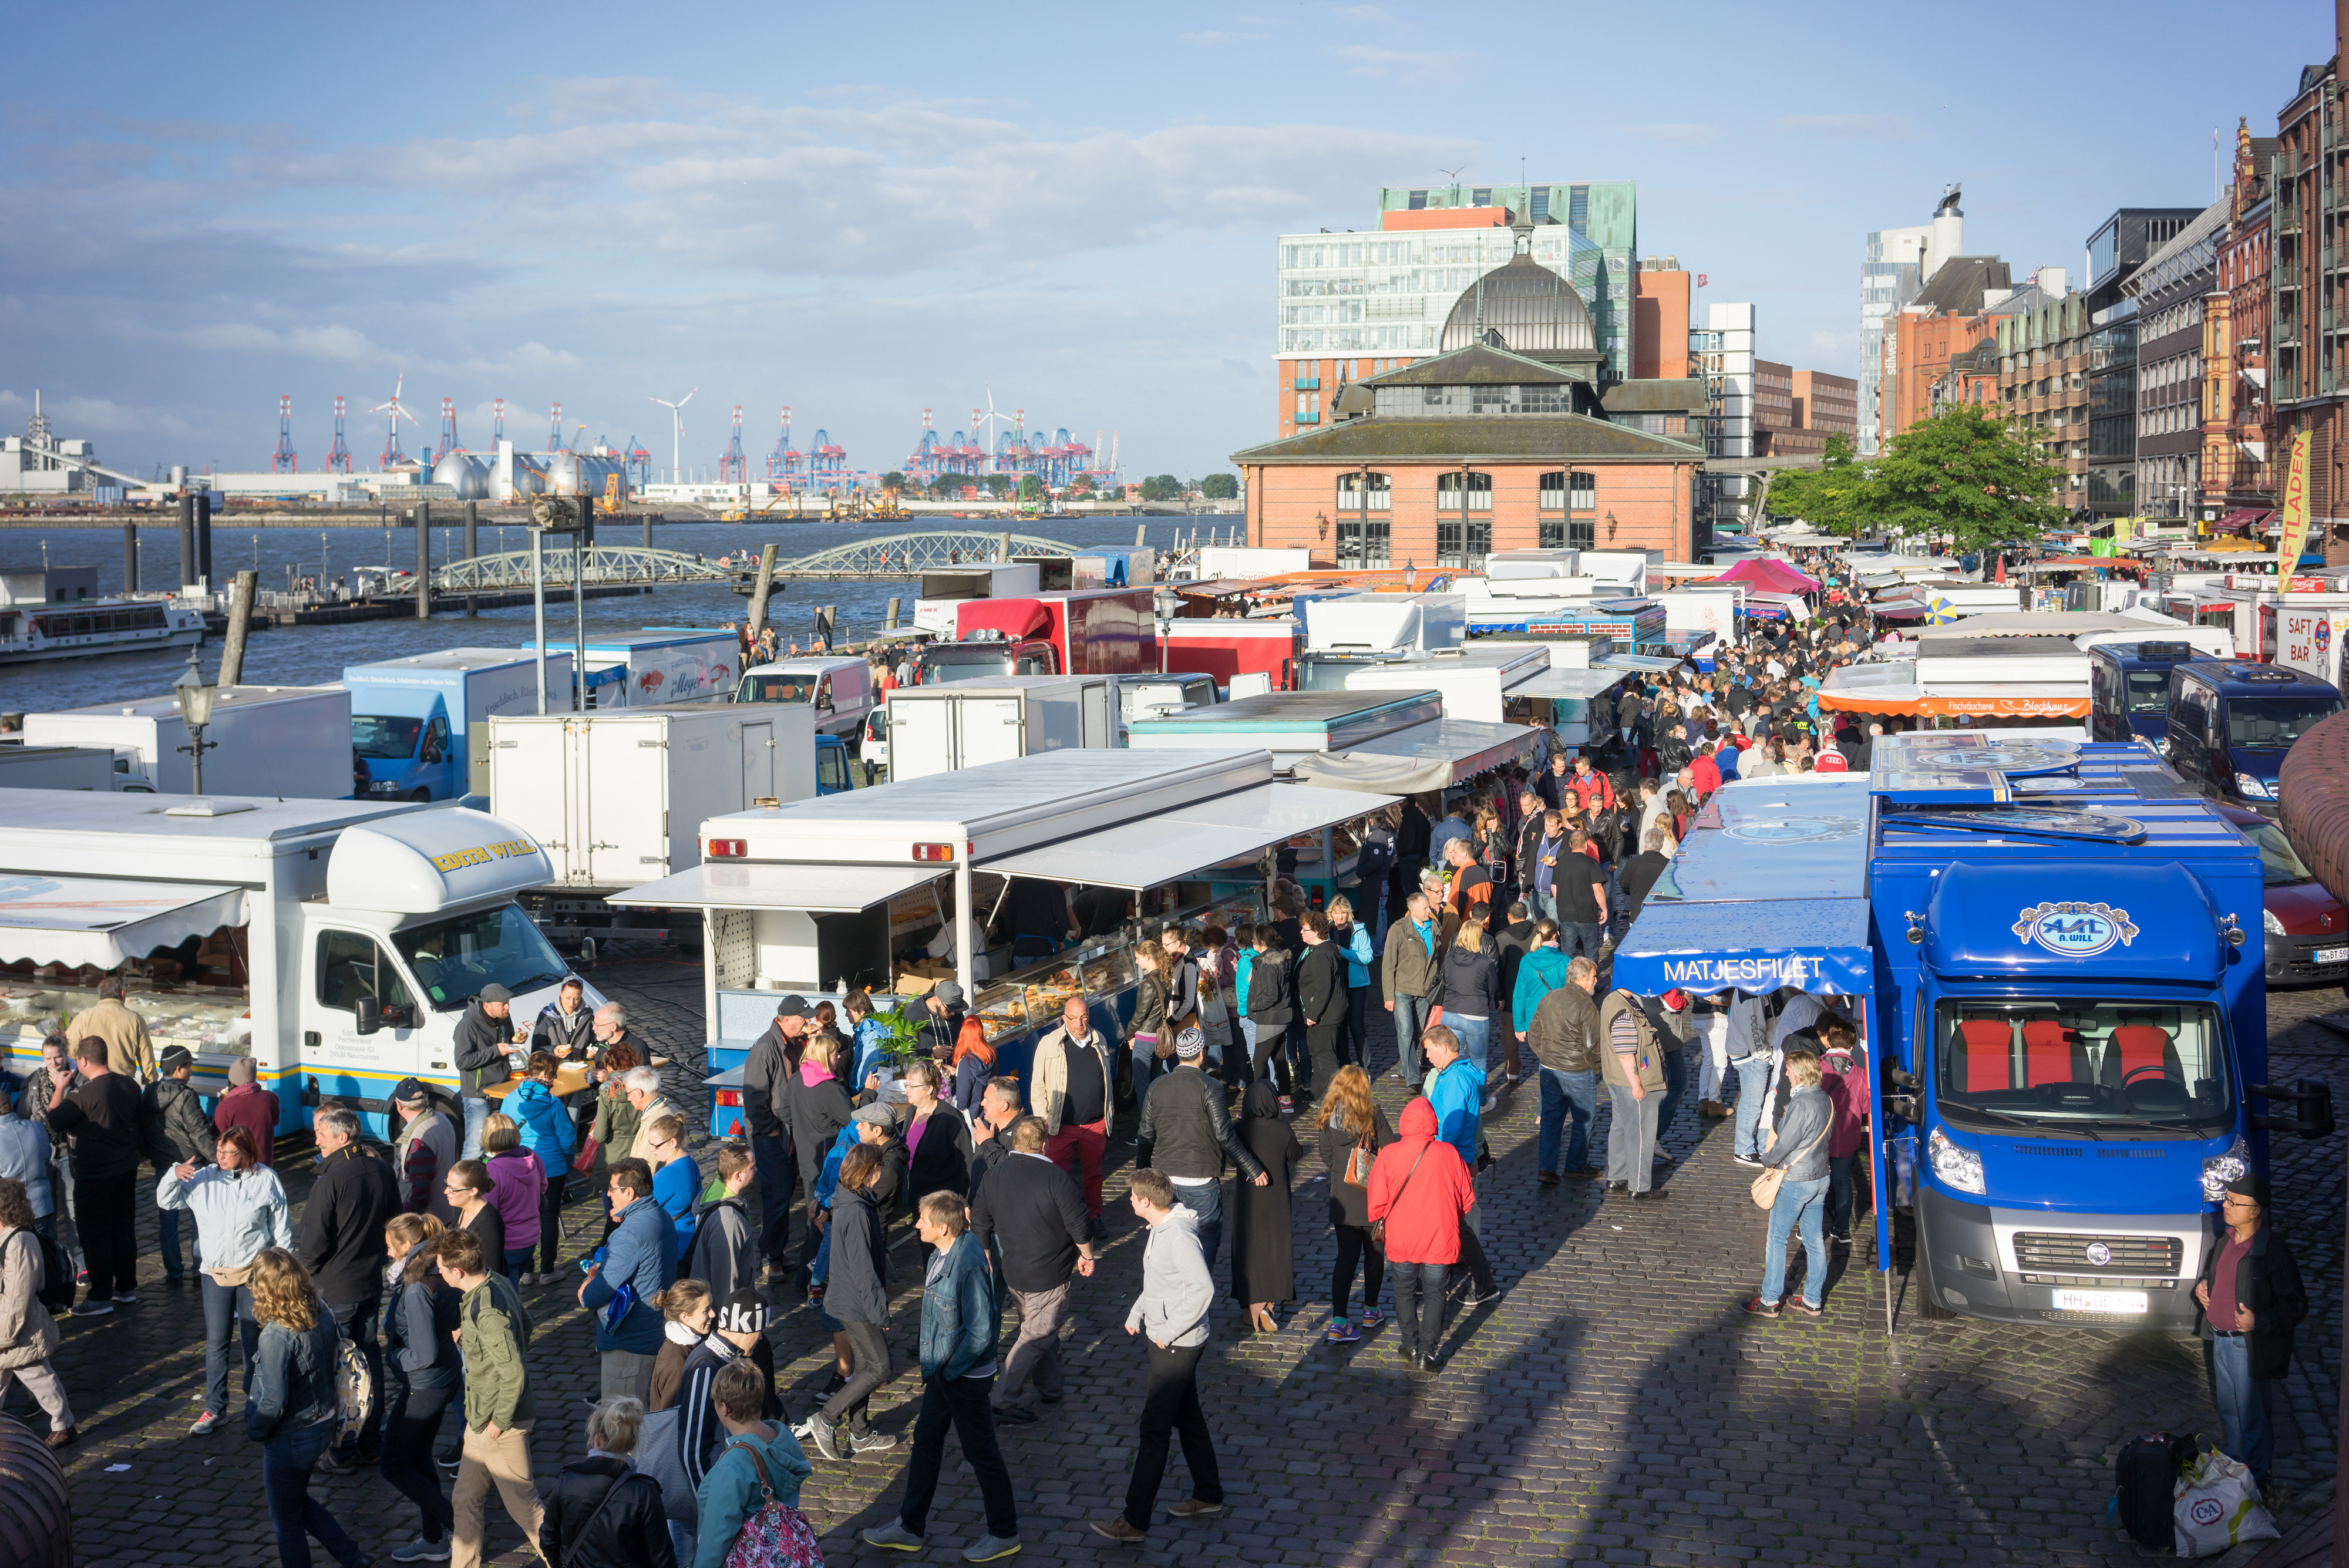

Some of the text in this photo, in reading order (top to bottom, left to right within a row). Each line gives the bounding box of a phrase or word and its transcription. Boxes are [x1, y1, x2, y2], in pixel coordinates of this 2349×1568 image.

[1885, 332, 1897, 376] stilwerk
[2289, 618, 2312, 635] SAFT
[2291, 645, 2310, 662] BAR
[671, 672, 704, 698] Meyer
[1948, 699, 2068, 712] Fischräucherei Blockhaus
[430, 839, 537, 873] EDITH WILL
[2318, 951, 2326, 960] HH
[2330, 950, 2338, 959] BT
[1664, 957, 1824, 981] MATJESFILET
[338, 1036, 372, 1045] Fischfeinkost
[2064, 1293, 2082, 1307] HH
[2196, 1503, 2220, 1519] C&A
